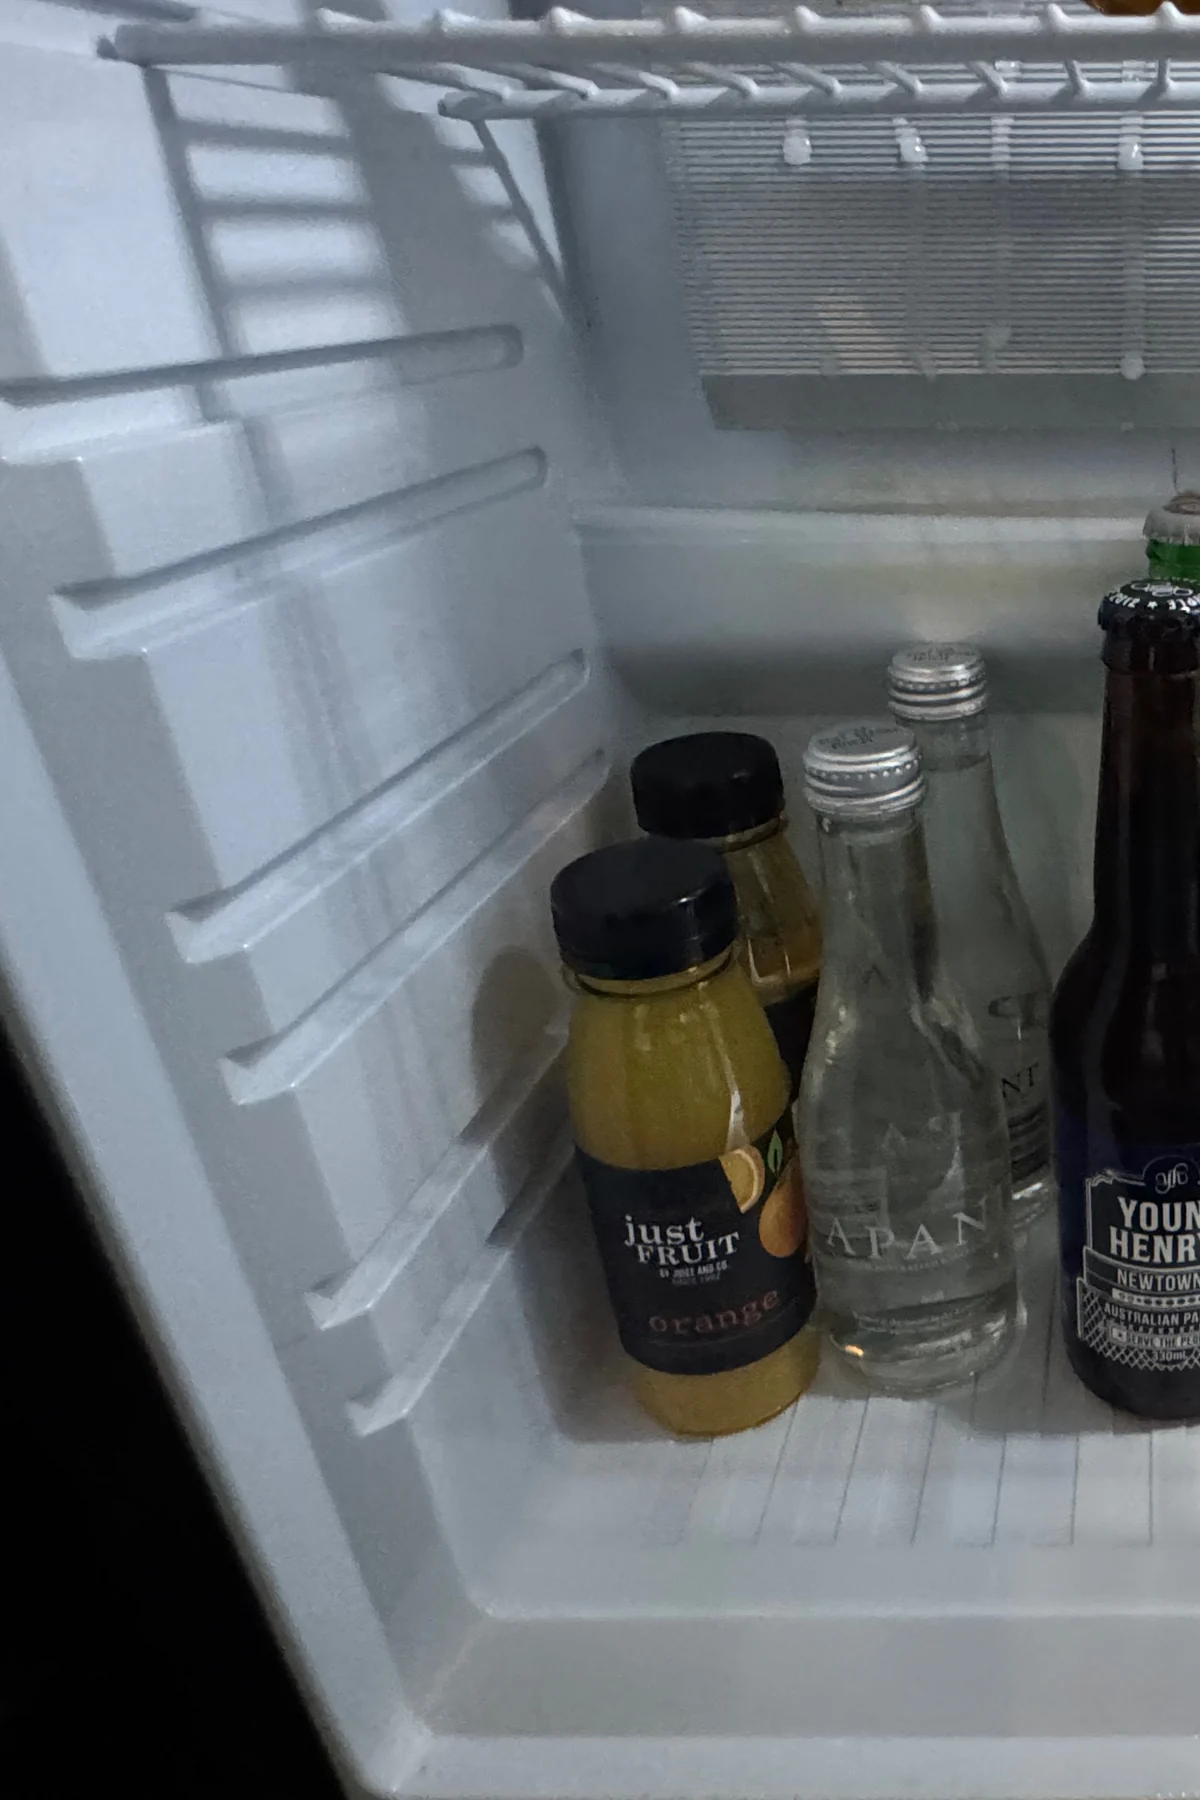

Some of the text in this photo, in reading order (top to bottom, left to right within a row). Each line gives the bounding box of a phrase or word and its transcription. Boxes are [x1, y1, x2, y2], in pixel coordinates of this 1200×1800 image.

[624, 1214, 705, 1247] just
[636, 1232, 740, 1266] FRUIT
[697, 1263, 714, 1275] AND
[649, 1290, 779, 1335] orange
[1103, 1301, 1180, 1326] AUSTRALIAN
